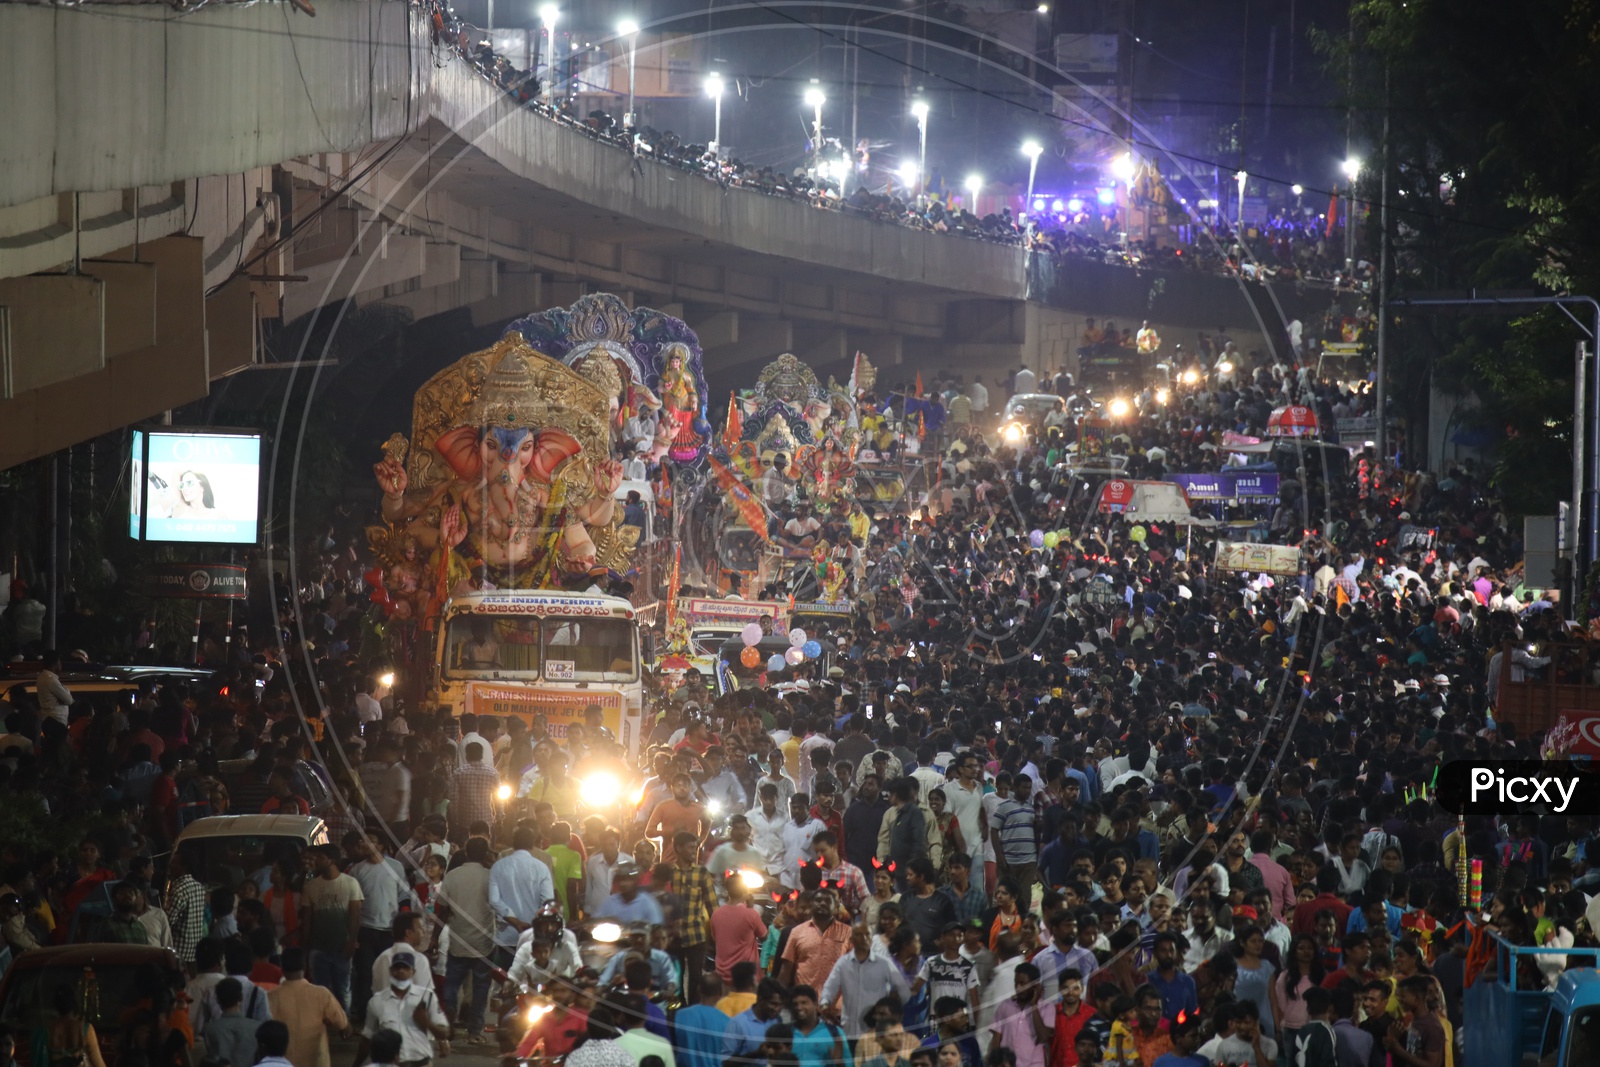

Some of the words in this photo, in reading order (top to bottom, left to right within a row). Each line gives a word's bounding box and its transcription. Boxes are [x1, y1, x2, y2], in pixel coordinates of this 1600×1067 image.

[1187, 482, 1218, 492] Amul
[1237, 477, 1261, 487] mul
[159, 575, 186, 586] TODAY,
[213, 577, 234, 586] ALIVE
[551, 598, 604, 606] PERMIT
[488, 689, 532, 702] GANESH
[536, 692, 572, 705] UTSAV
[574, 695, 619, 708] SAMITHI
[493, 702, 509, 713] OLD
[561, 707, 575, 717] JET
